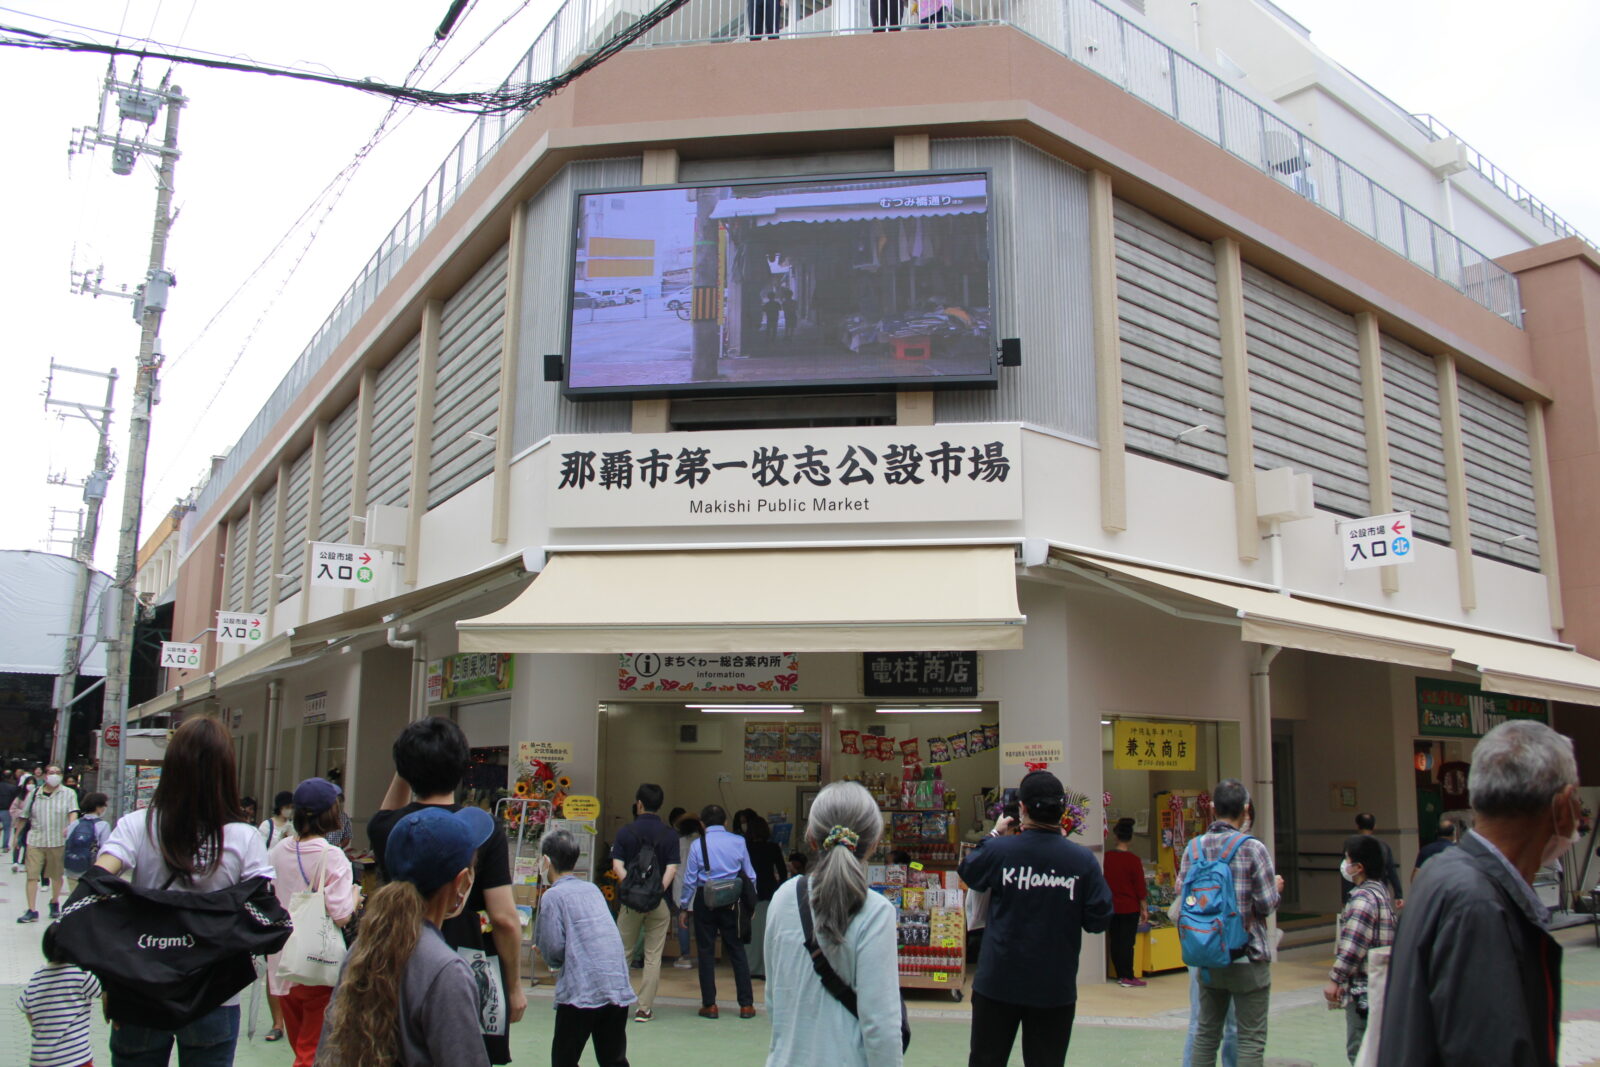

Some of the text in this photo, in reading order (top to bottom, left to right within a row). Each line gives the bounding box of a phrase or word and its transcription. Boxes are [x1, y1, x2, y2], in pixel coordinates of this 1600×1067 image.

[558, 441, 1011, 490] 那覇市第一牧志公設市場
[689, 496, 870, 514] Makishi Public Market
[1350, 525, 1386, 538] 公設市場
[320, 551, 354, 561] 公設市場
[1351, 541, 1387, 561] 入口
[317, 564, 352, 580] 入口
[221, 626, 247, 638] 入口
[165, 654, 186, 664] 入口
[872, 656, 971, 683] 電柱商店
[1126, 737, 1187, 758] 兼次商店
